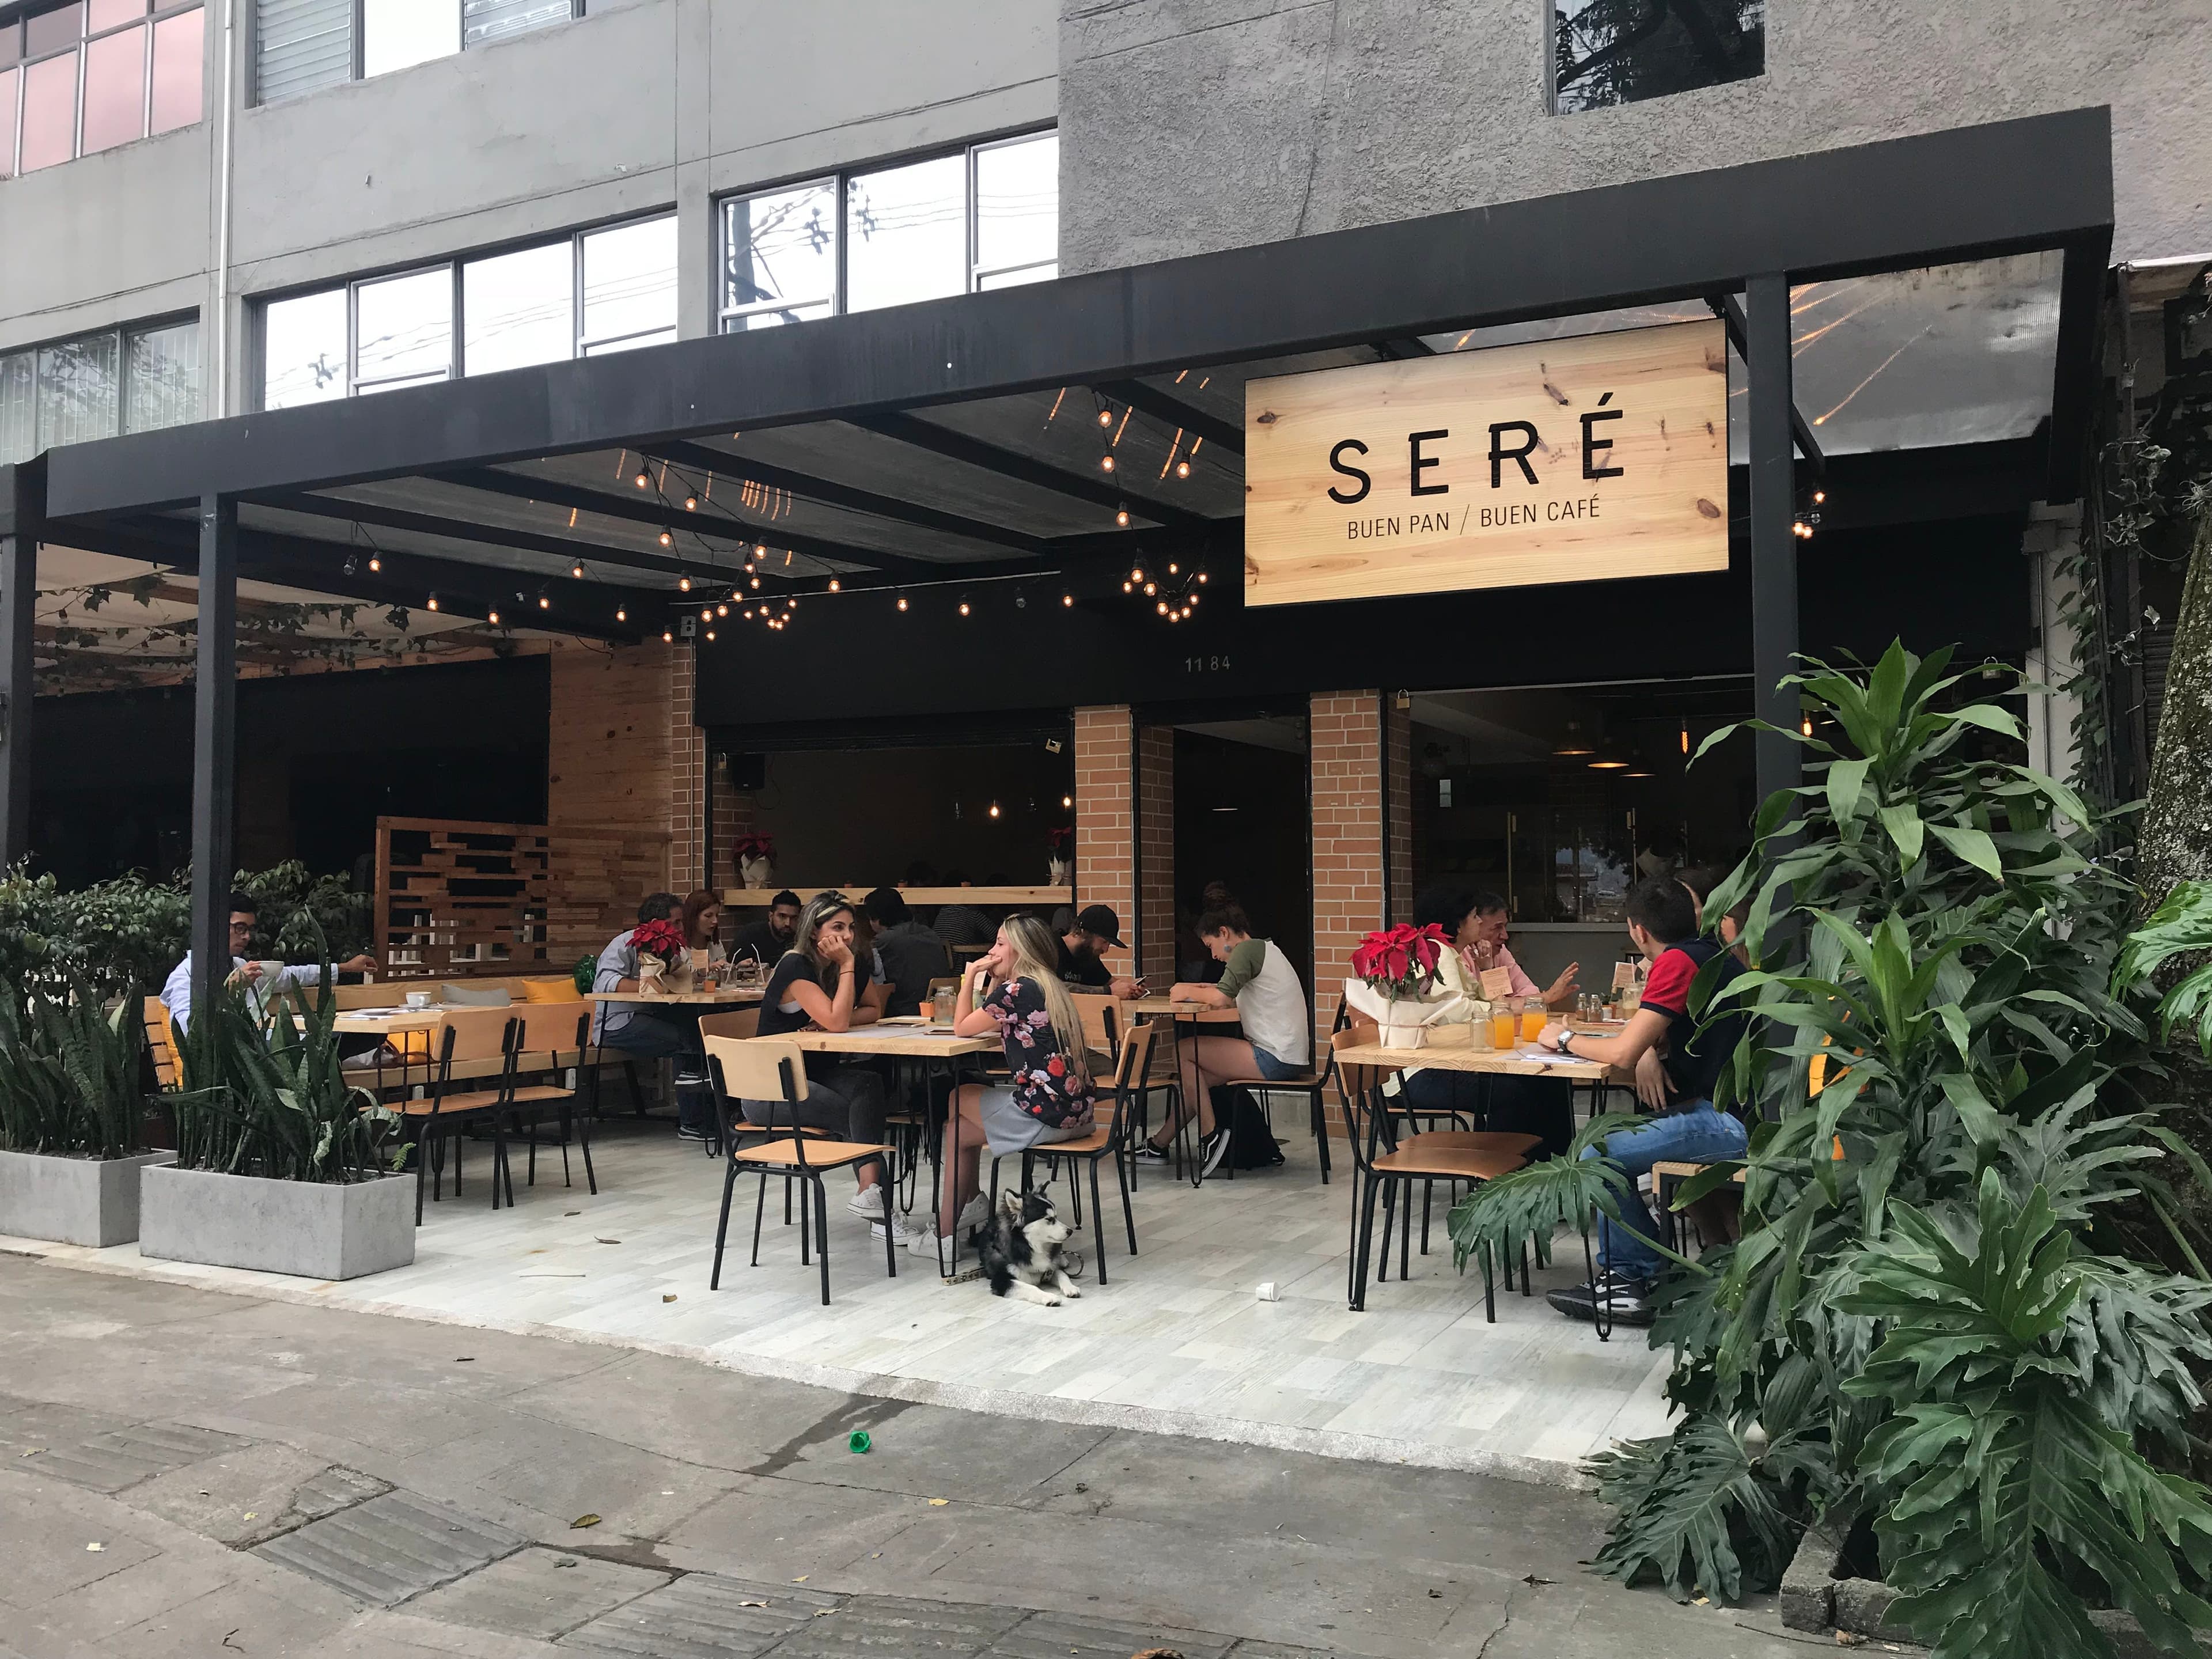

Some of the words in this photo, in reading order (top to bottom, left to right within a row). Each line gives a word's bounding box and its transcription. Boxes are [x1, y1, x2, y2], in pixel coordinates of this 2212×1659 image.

[1327, 392, 1624, 505] SERÉ
[1348, 517, 1400, 540] BUEN
[1410, 512, 1449, 534] PAN
[1480, 503, 1536, 528] BUEN
[1547, 493, 1600, 522] CAFÉ
[1185, 657, 1203, 673] 11
[1210, 655, 1231, 671] 84
